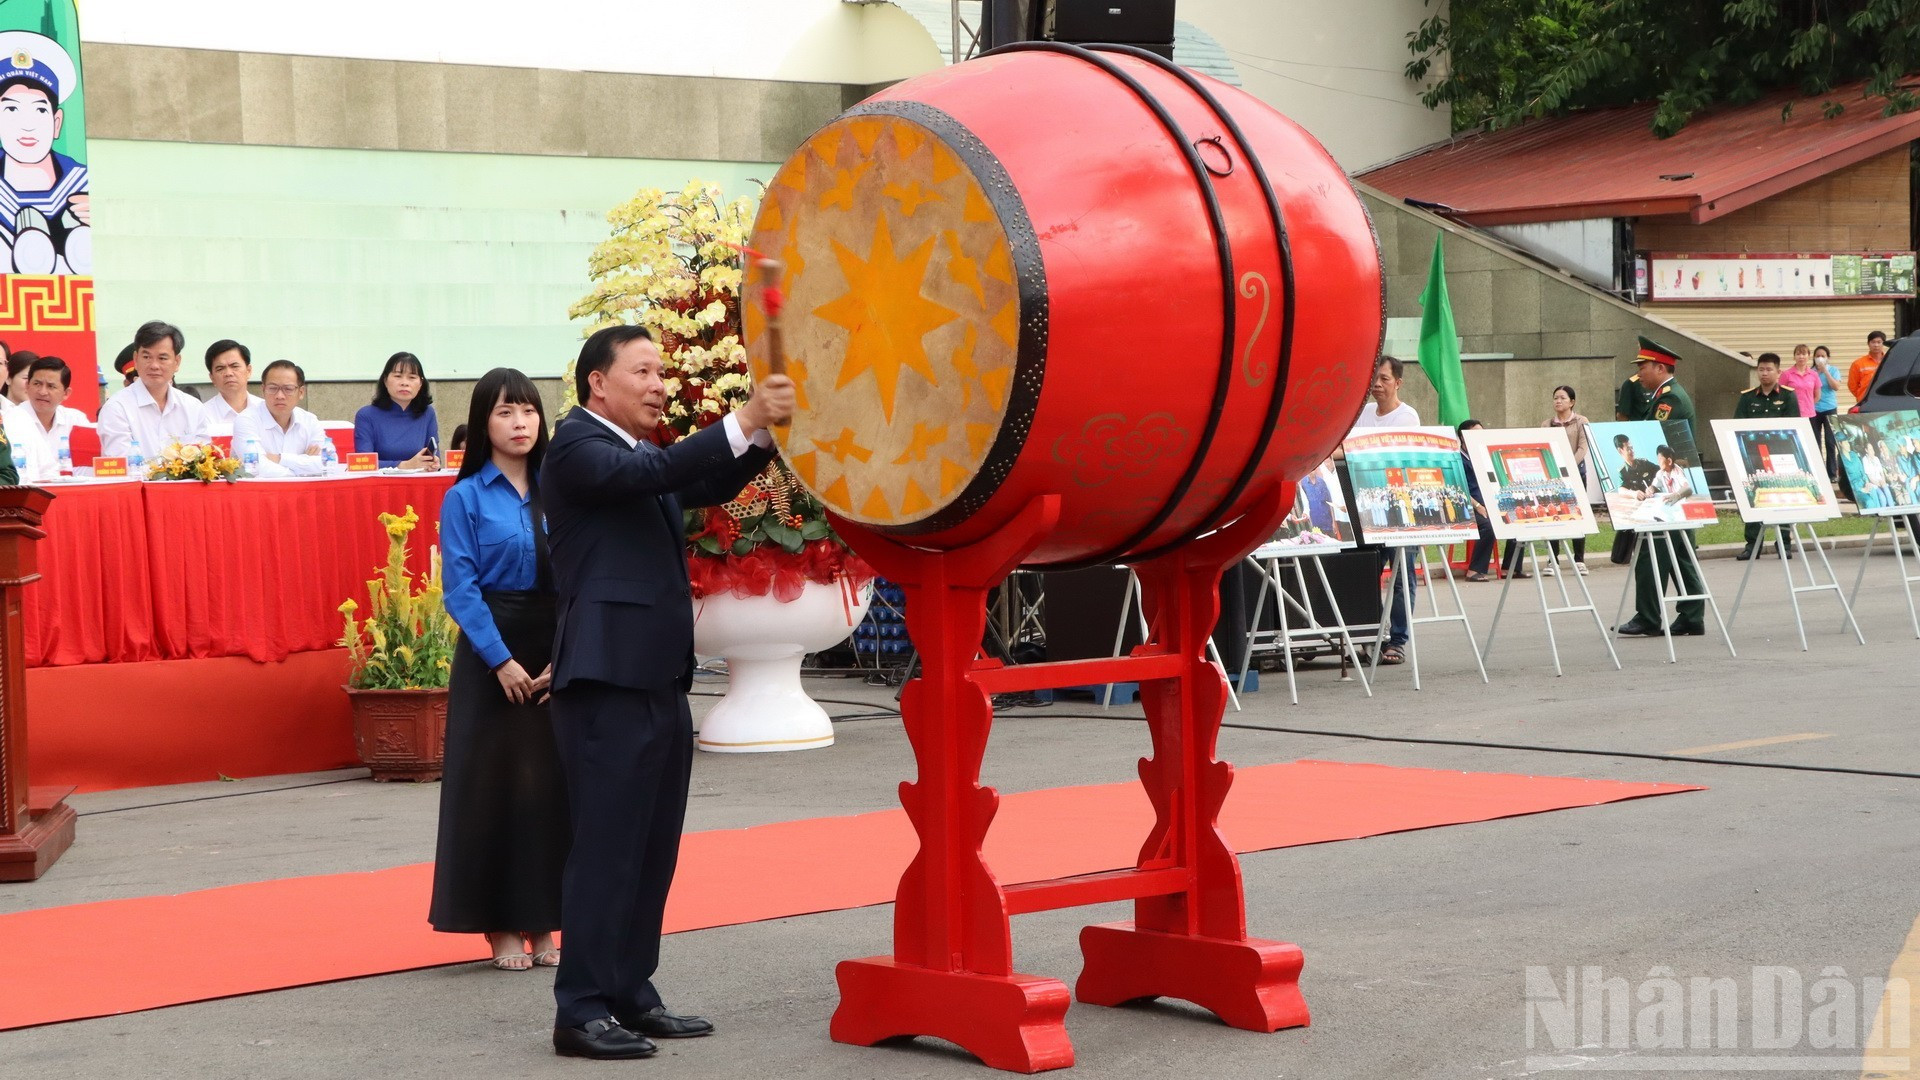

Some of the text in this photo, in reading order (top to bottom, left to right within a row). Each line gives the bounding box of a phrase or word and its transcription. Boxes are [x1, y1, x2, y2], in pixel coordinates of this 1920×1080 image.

[6, 69, 24, 78] QUÂN
[25, 70, 39, 78] VIỆT
[39, 75, 53, 87] NAM
[1393, 434, 1407, 443] NAM
